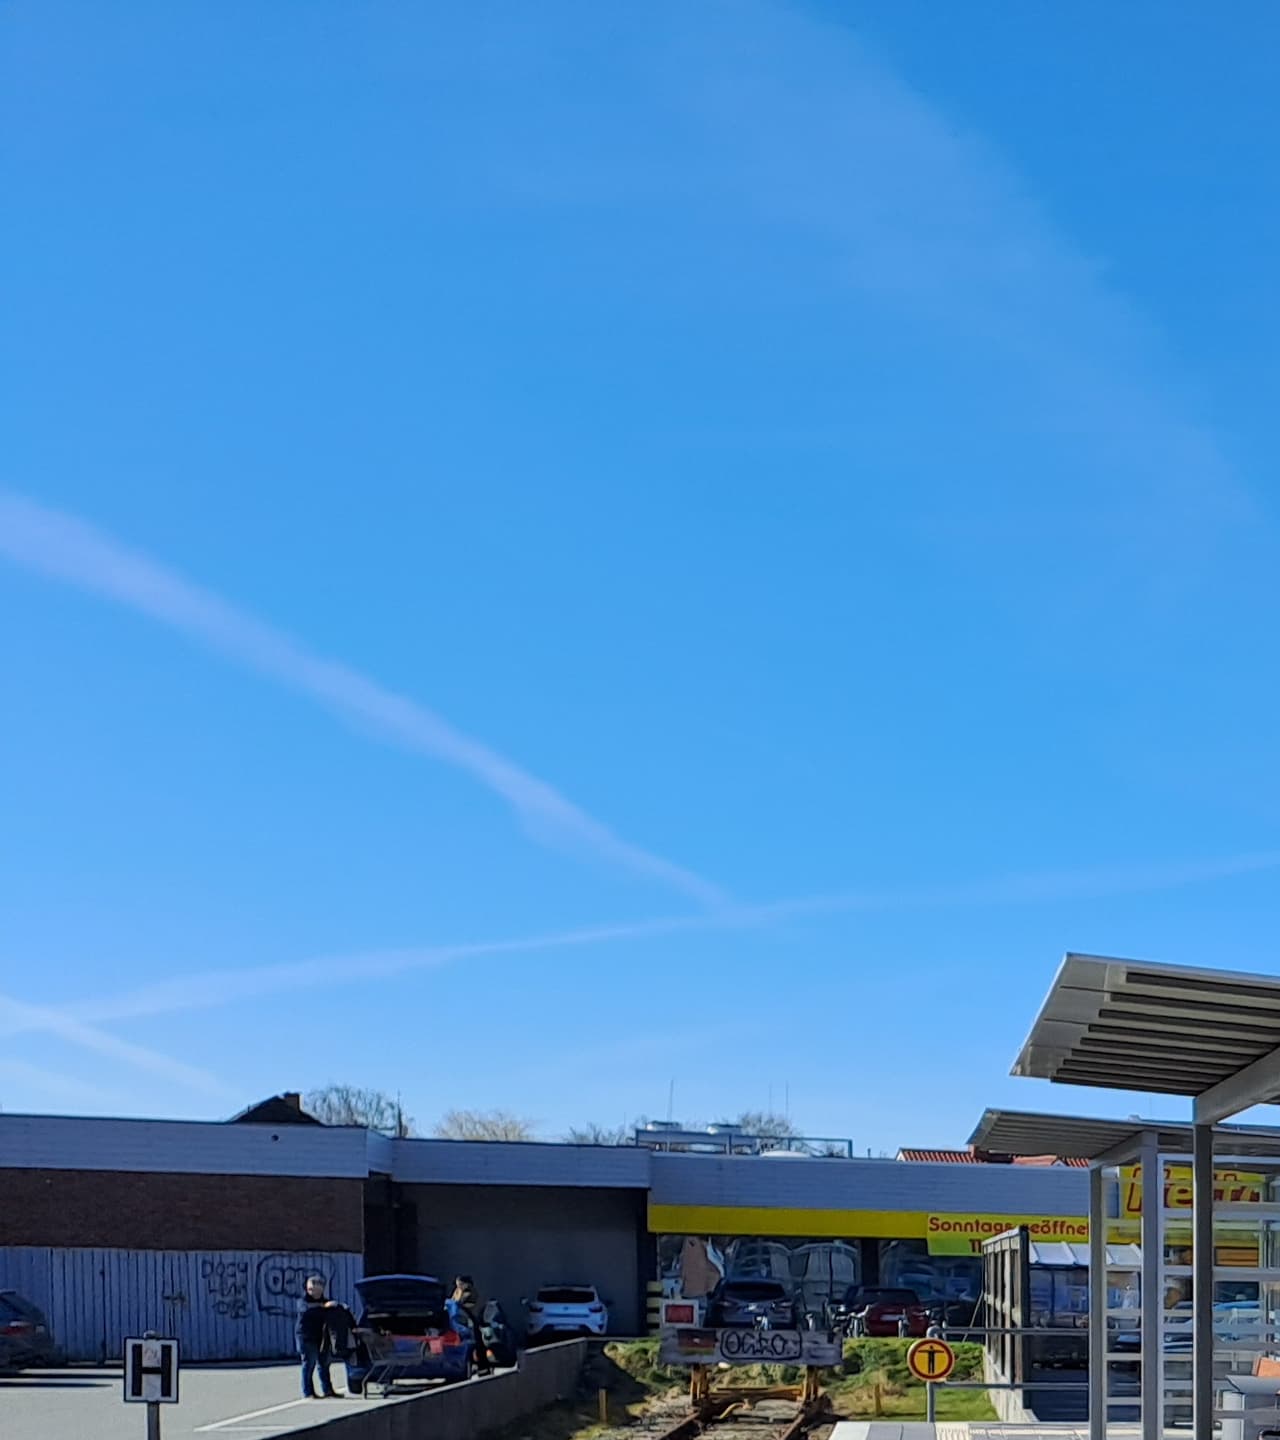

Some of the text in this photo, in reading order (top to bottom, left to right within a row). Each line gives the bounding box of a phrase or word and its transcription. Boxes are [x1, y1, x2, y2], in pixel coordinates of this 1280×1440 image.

[928, 1216, 1089, 1235] Sonntags eöffne
[131, 1343, 172, 1397] H
